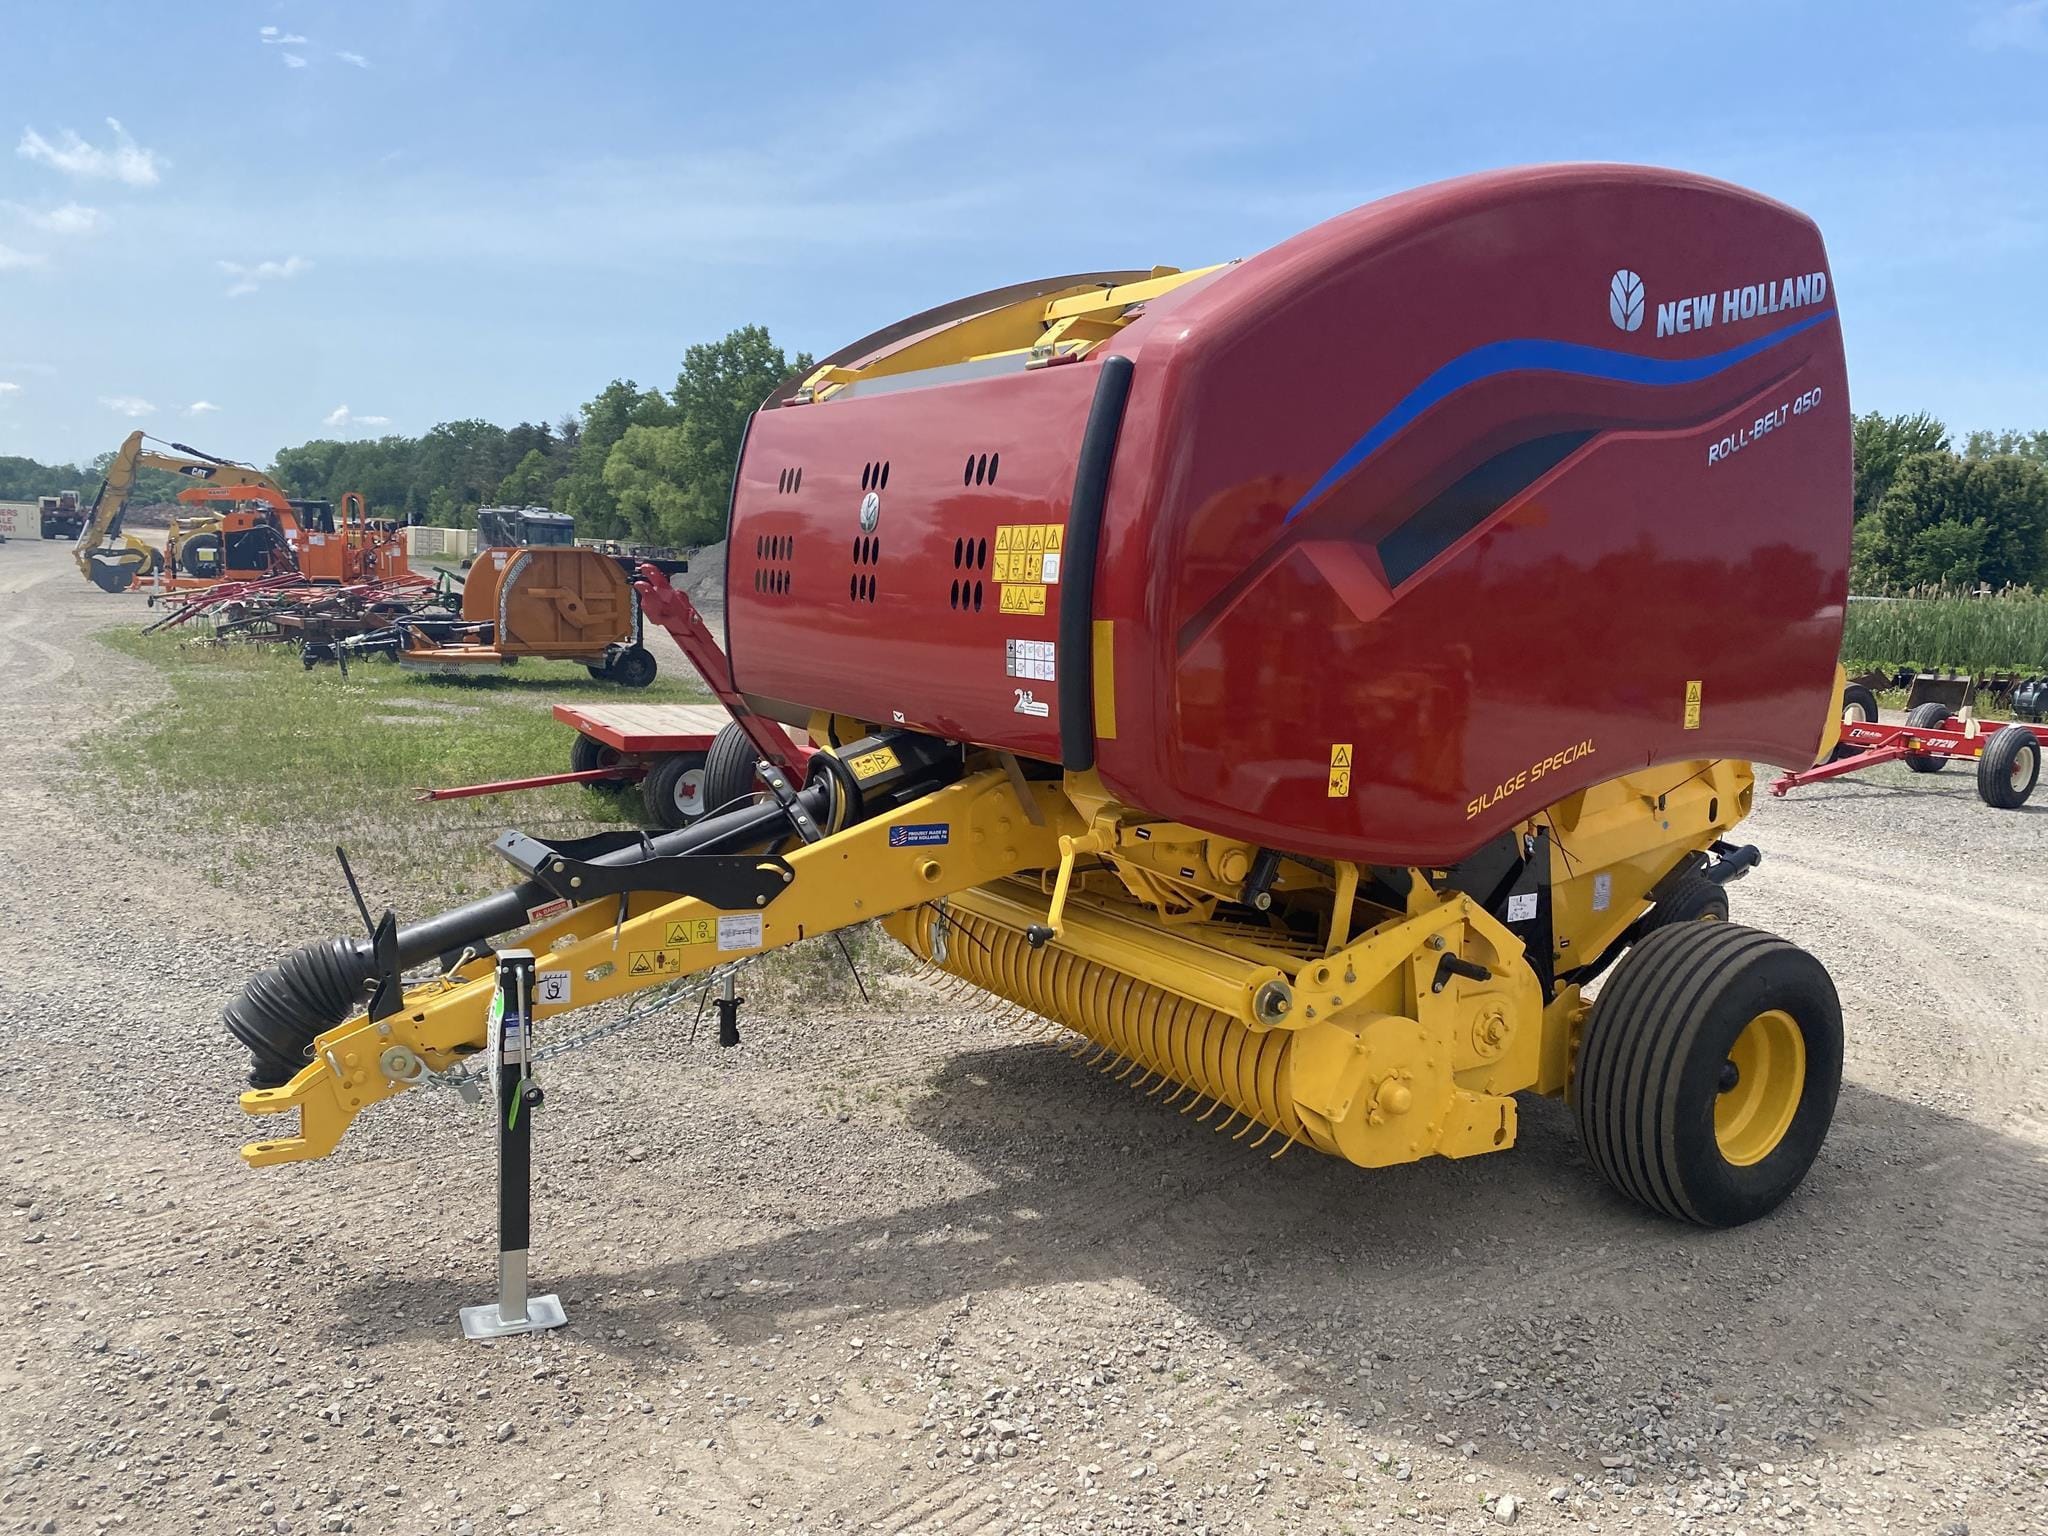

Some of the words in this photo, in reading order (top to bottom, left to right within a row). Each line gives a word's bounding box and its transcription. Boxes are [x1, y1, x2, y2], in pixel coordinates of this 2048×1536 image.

[1656, 294, 1716, 338] NEW
[1722, 271, 1827, 324] HOLLAND
[1708, 403, 1789, 467] ROLL-BELT
[1793, 387, 1822, 416] 450
[191, 467, 208, 479] CAT
[1466, 770, 1527, 821] SILAGE
[1530, 738, 1596, 783] SPECIAL
